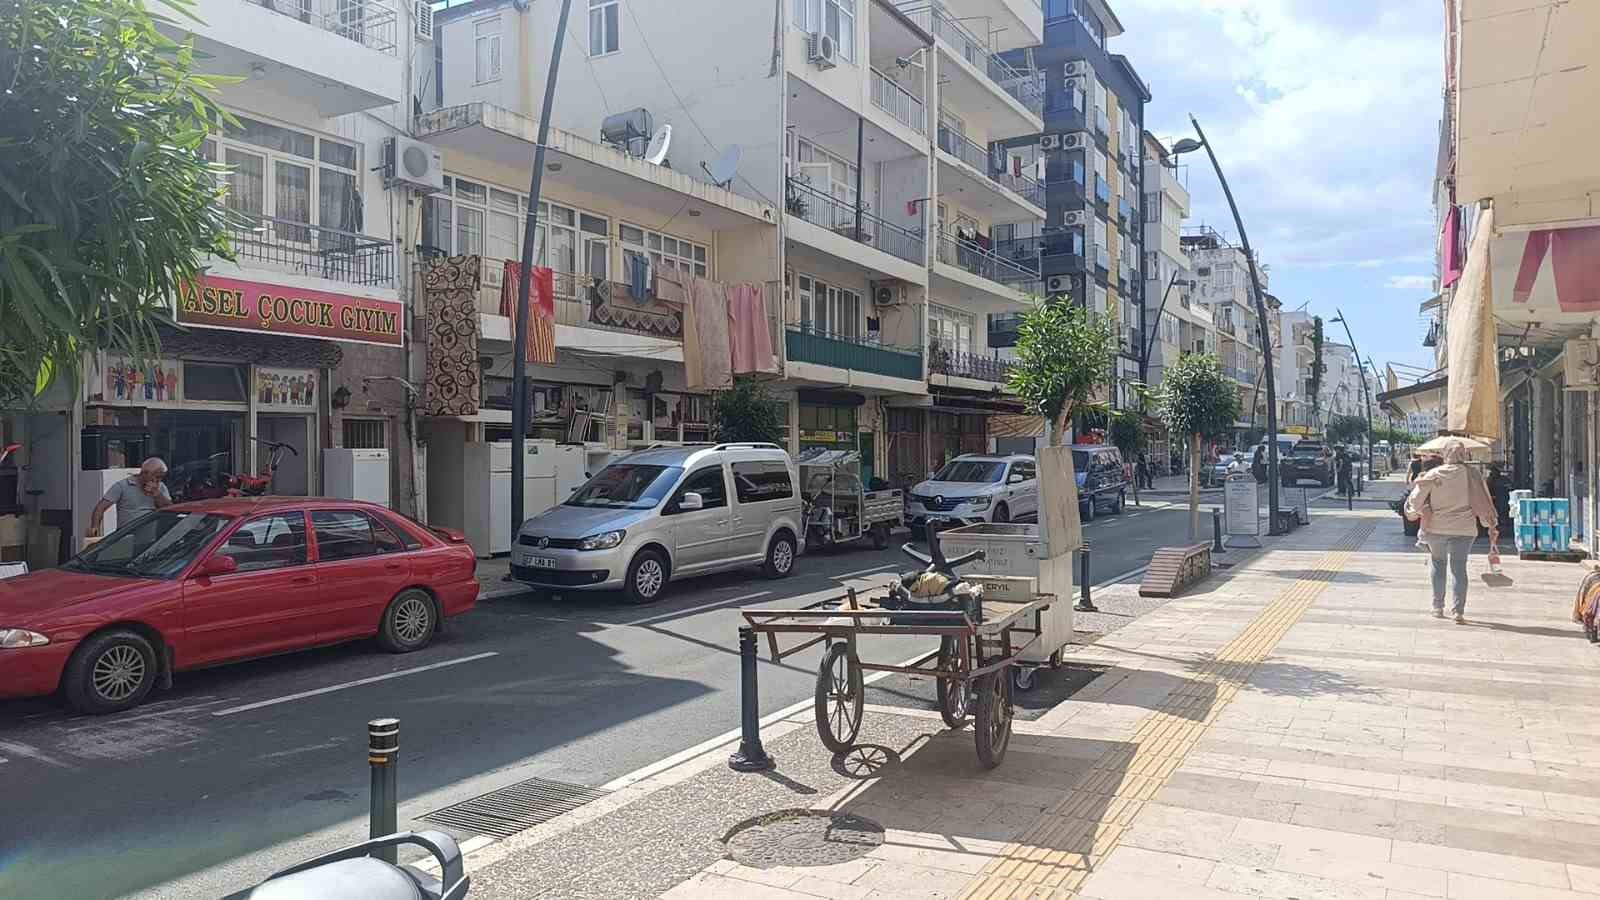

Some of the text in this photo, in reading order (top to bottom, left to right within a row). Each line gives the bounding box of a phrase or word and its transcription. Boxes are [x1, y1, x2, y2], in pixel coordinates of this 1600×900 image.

[184, 287, 398, 335] ASEL ÇOCUK GİYİM
